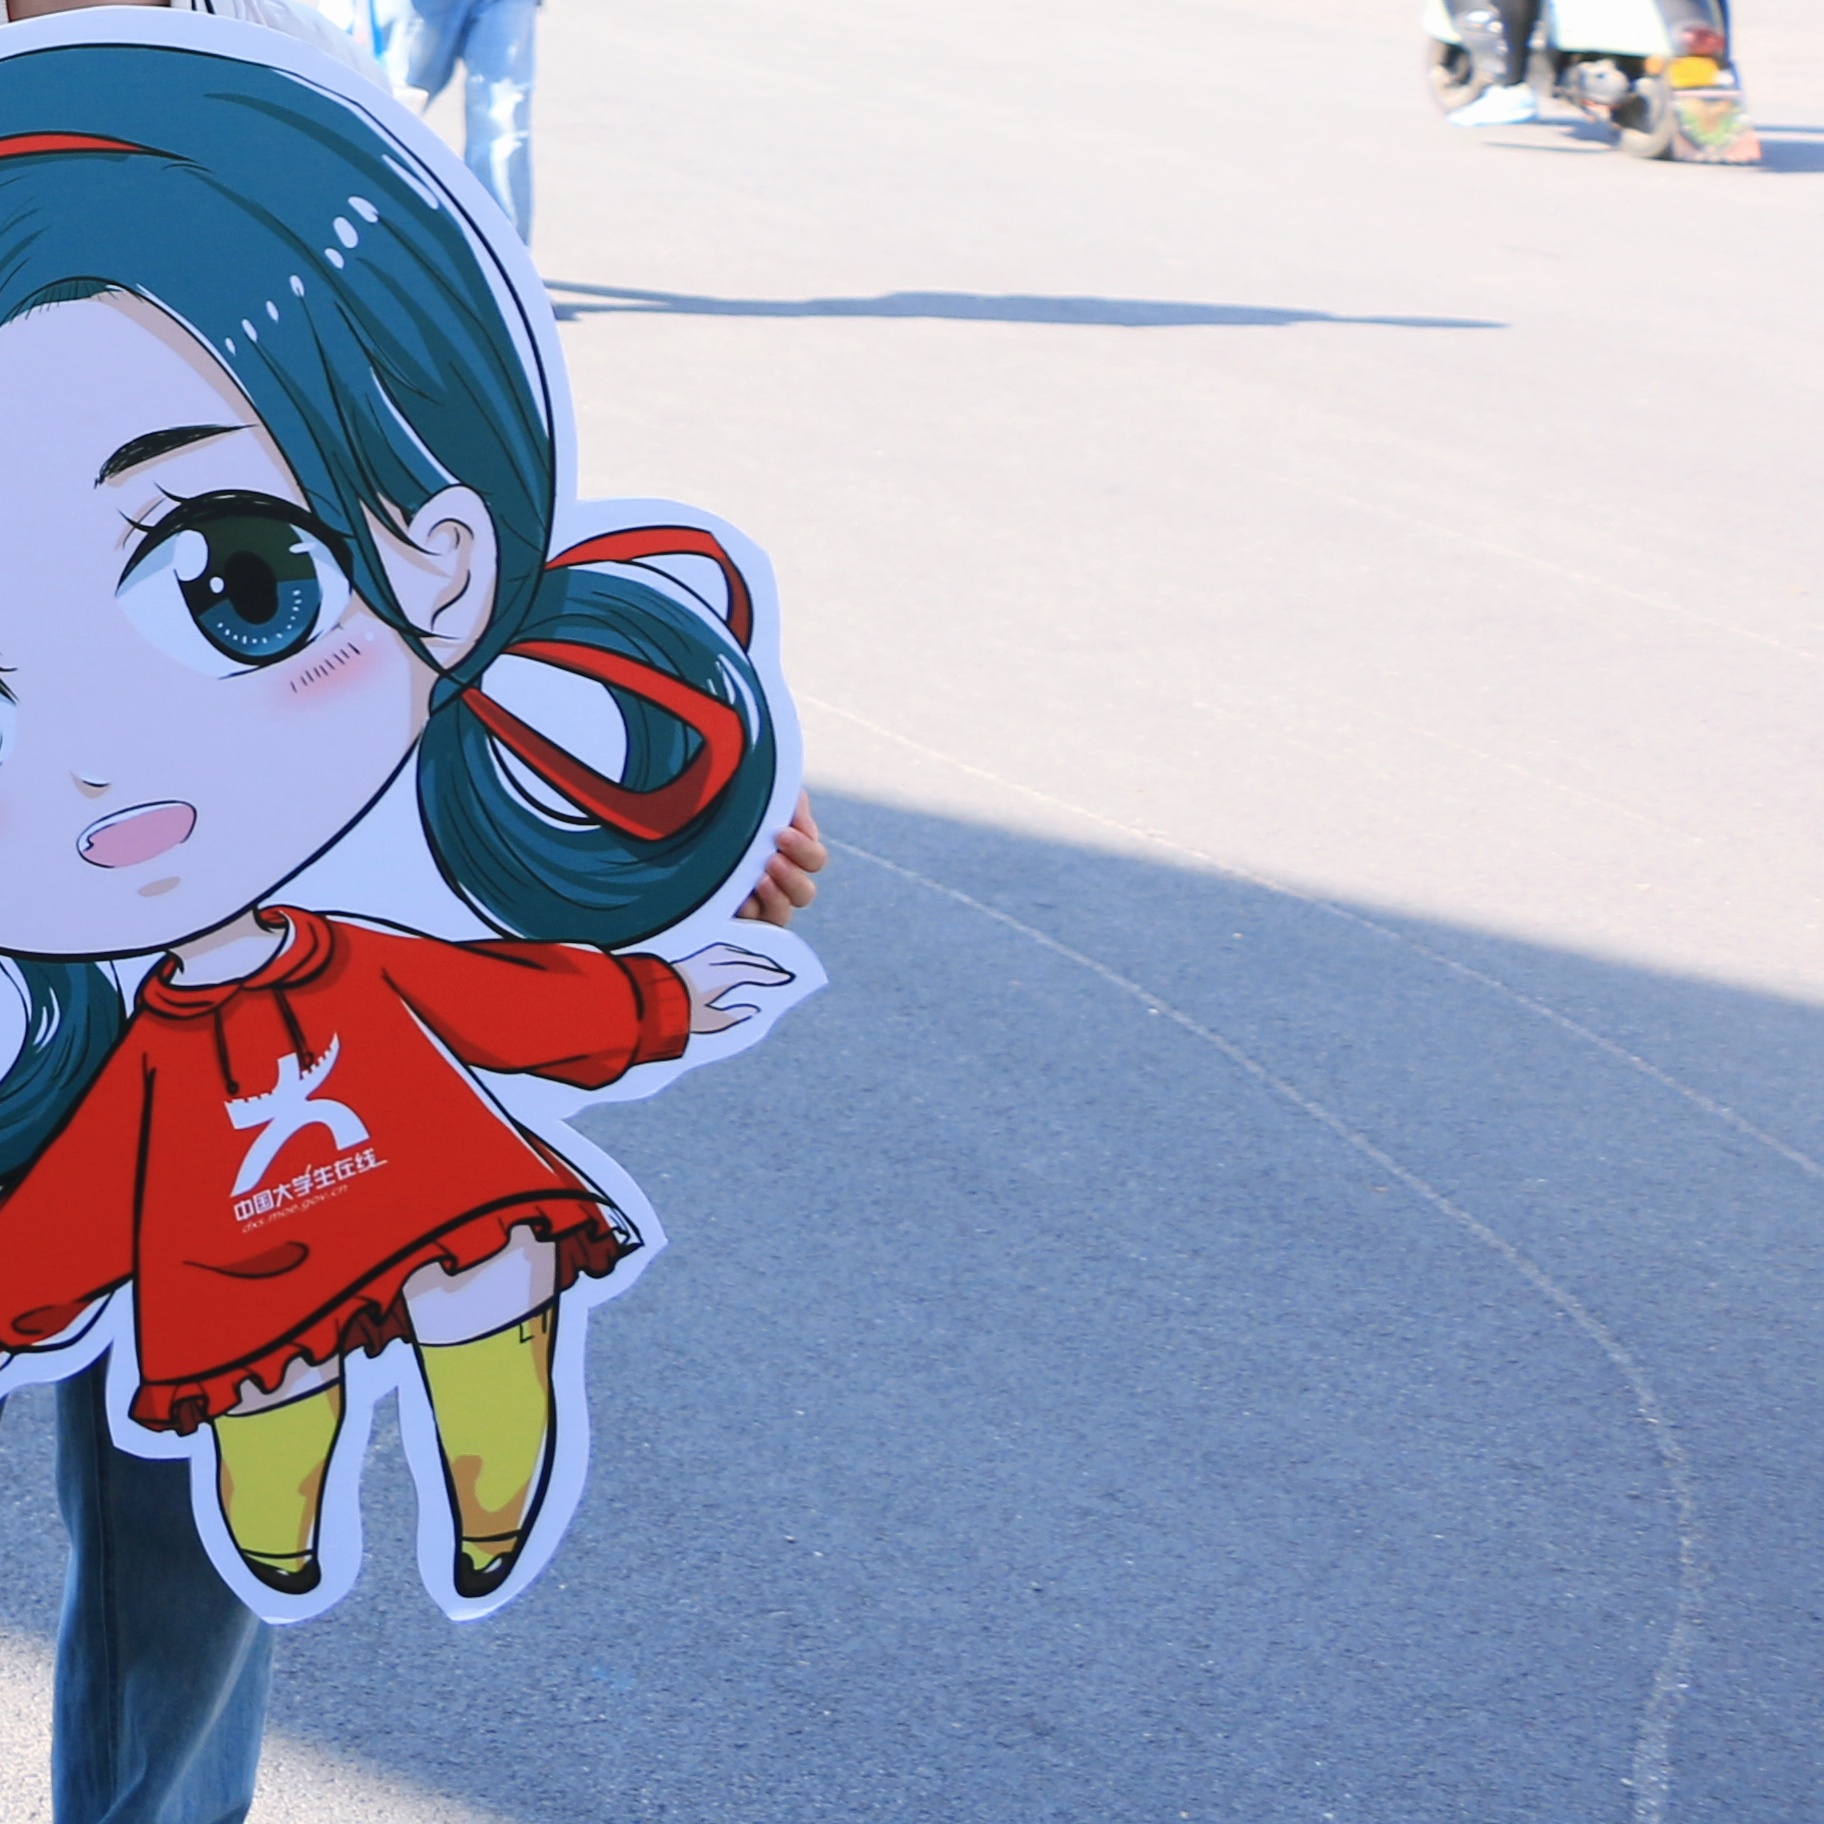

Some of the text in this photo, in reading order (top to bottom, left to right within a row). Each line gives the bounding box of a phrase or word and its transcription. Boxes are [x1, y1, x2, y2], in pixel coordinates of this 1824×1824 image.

[232, 1147, 388, 1222] 中国大学生在线
